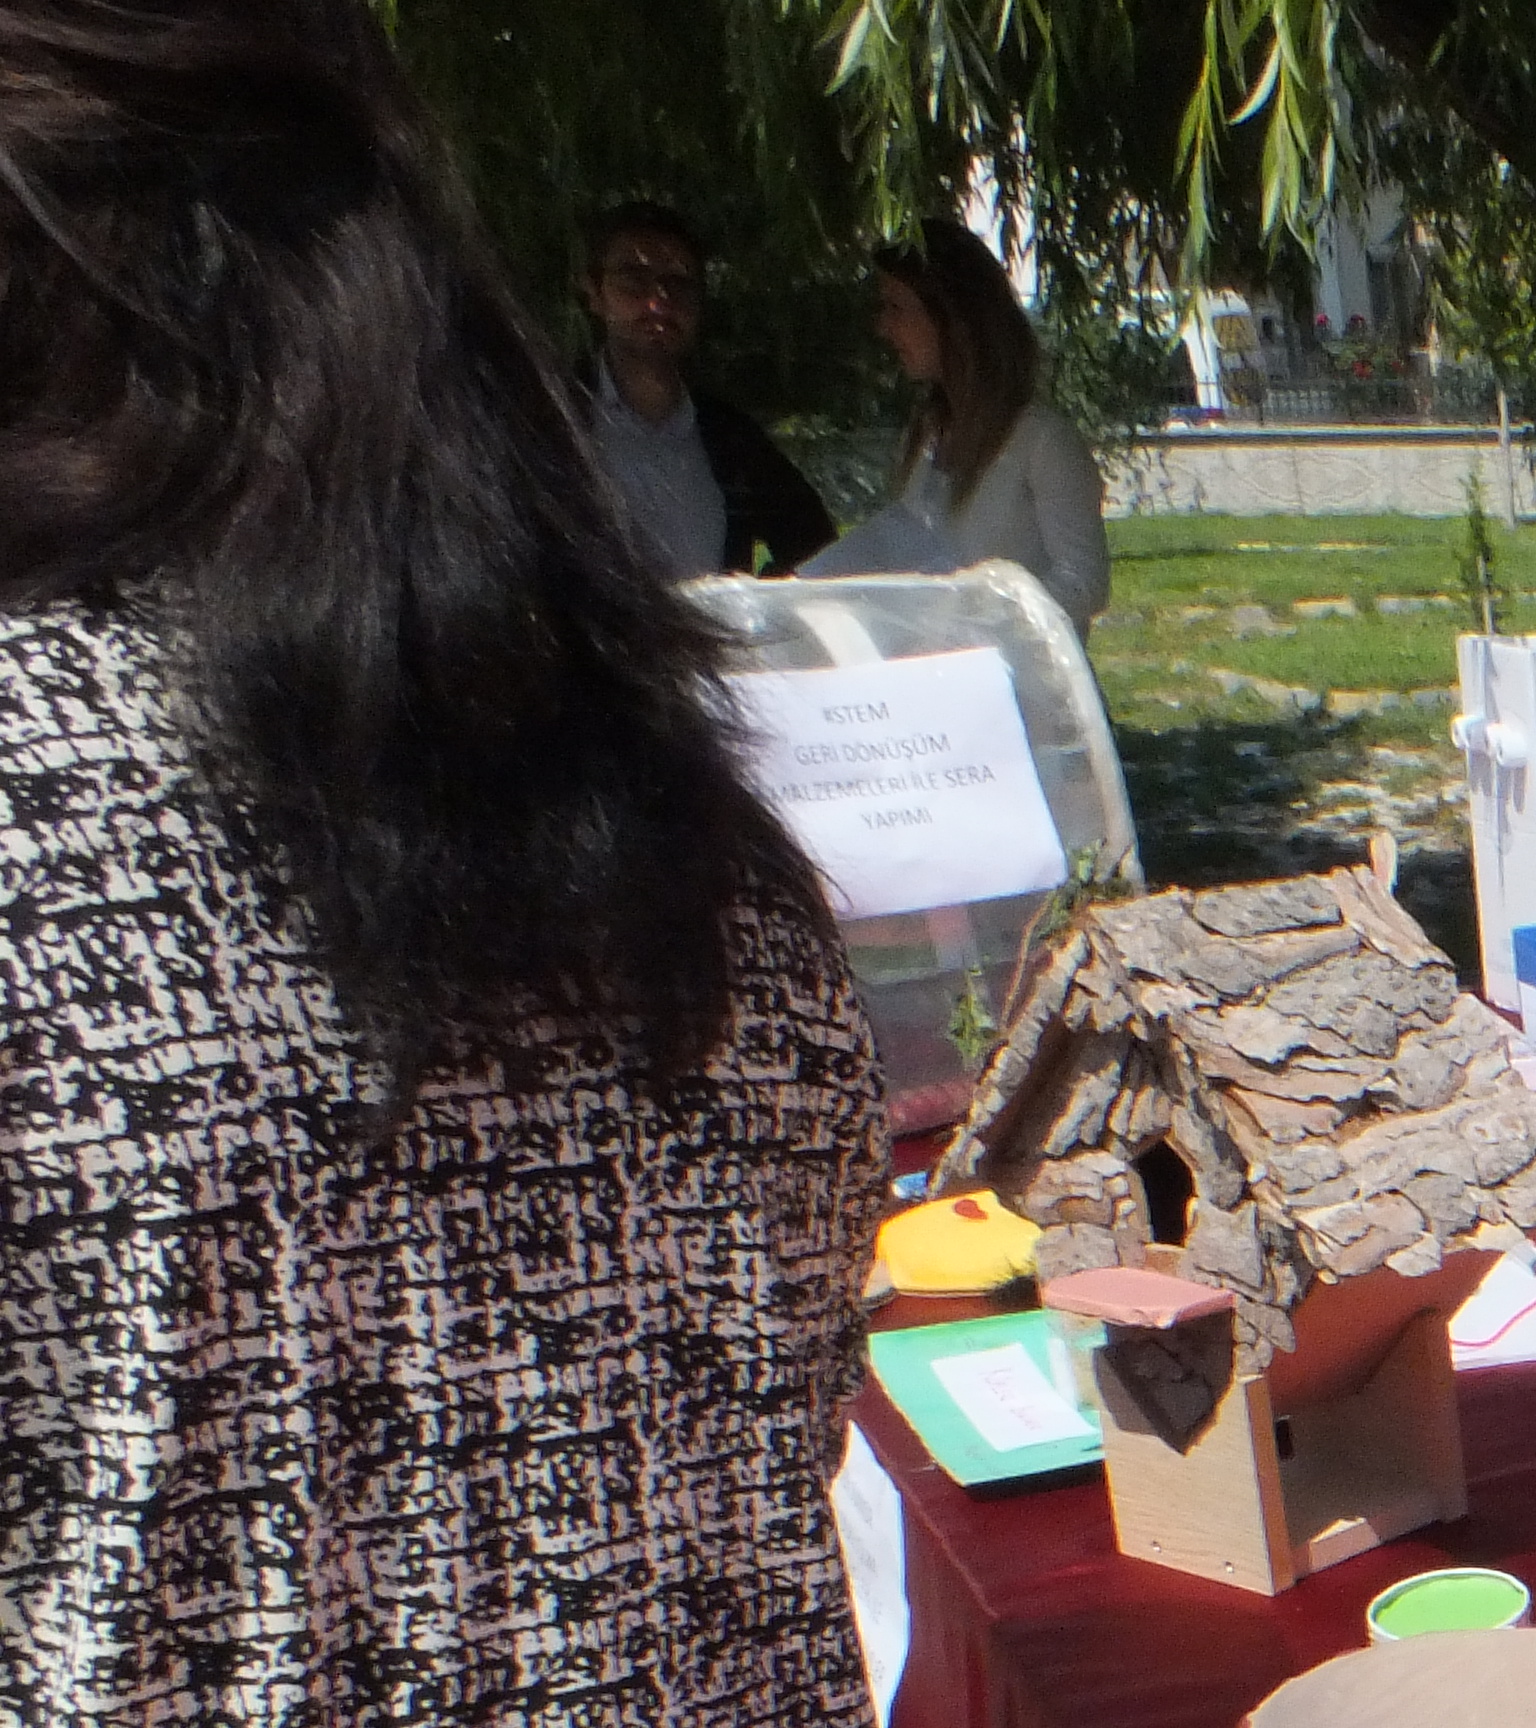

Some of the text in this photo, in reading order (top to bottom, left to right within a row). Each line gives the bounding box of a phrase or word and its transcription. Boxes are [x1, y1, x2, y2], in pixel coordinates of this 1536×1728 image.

[794, 732, 952, 766] GERİ DÖNÜŞÜM
[942, 763, 998, 789] SERA
[859, 806, 934, 830] YAPIMI
